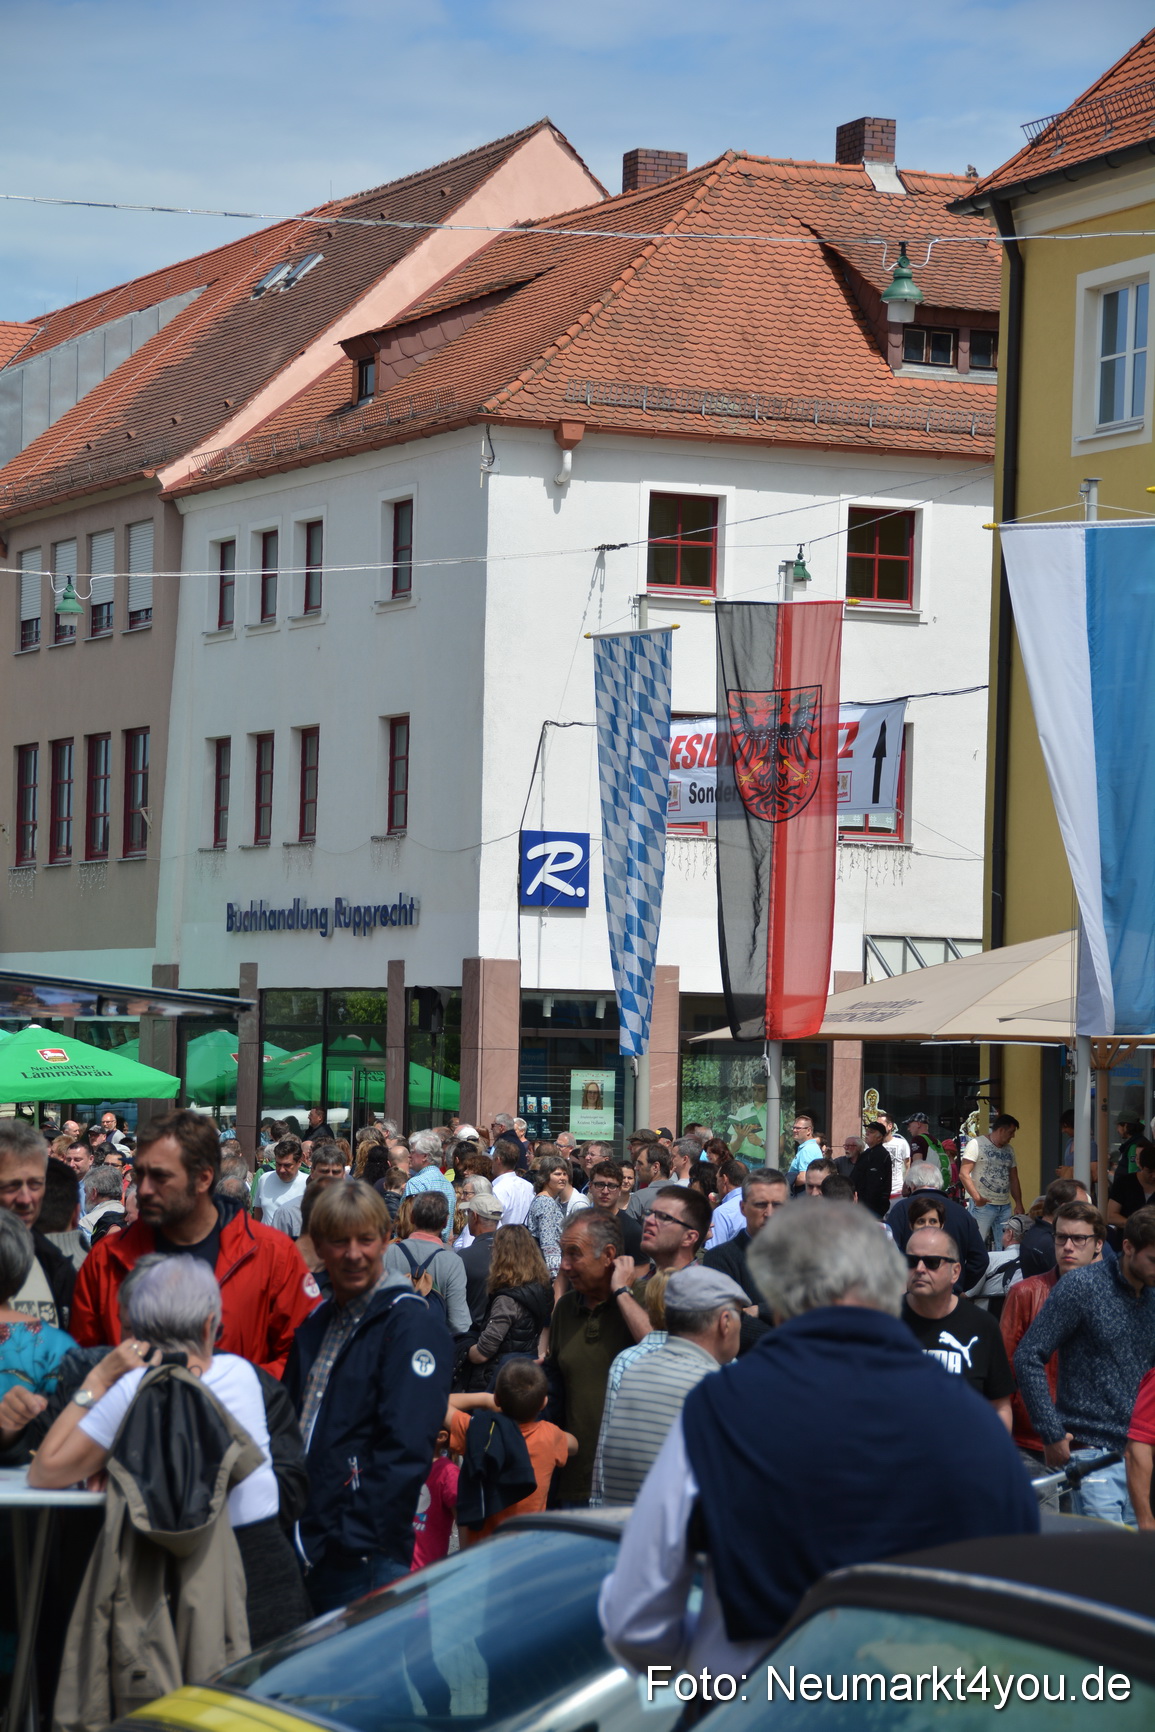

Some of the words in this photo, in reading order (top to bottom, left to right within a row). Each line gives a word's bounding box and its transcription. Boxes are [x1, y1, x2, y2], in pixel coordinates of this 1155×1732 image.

[226, 896, 331, 938] Buchhandlung
[334, 891, 418, 937] Rupprecht
[20, 1069, 113, 1079] Lammsbräu
